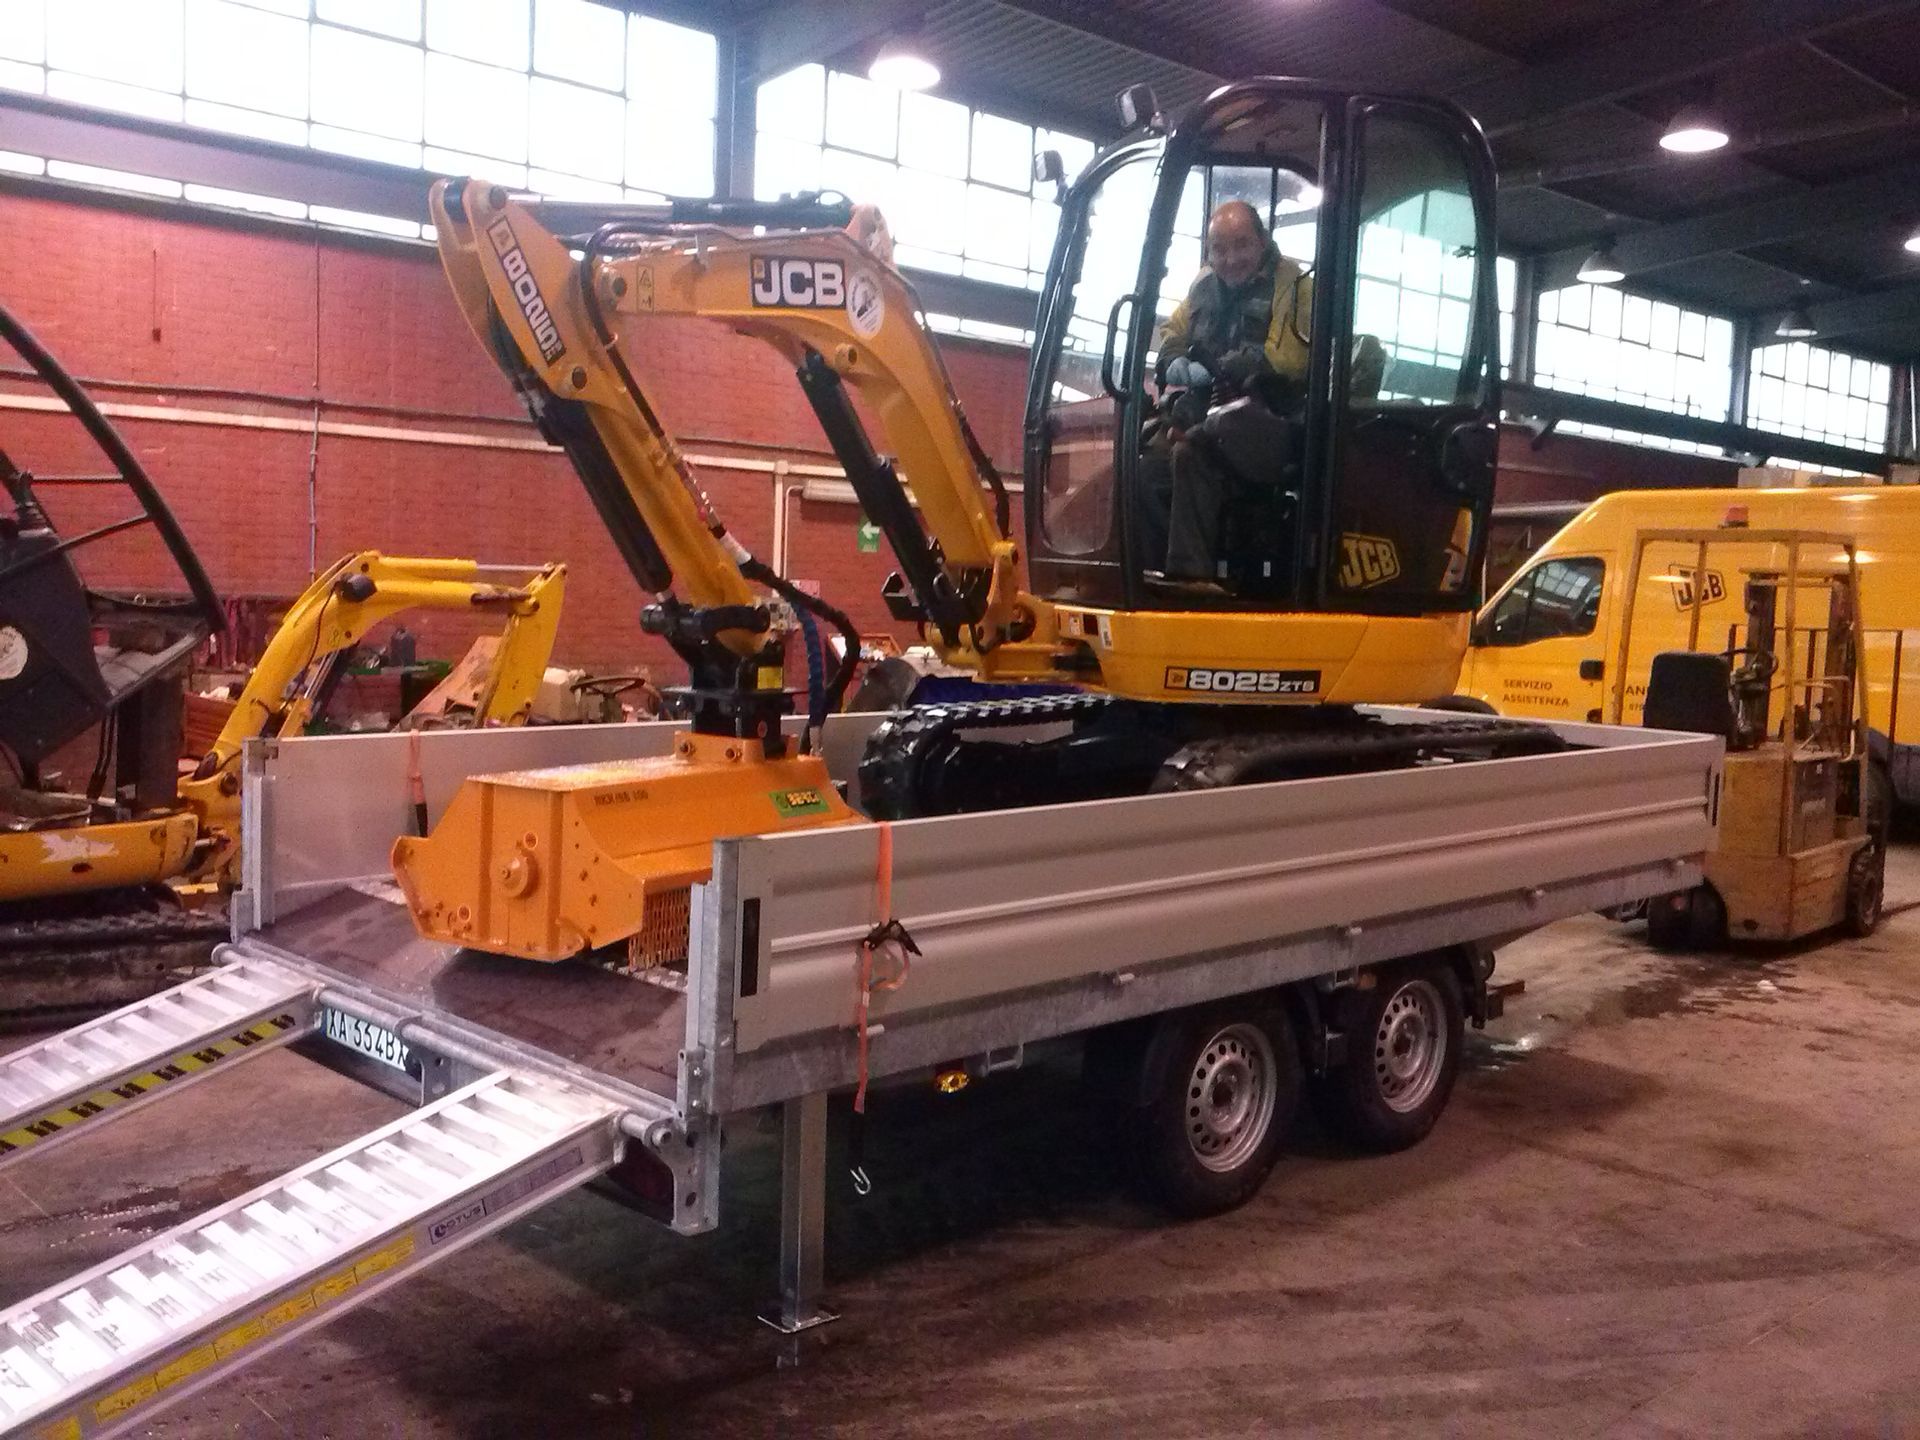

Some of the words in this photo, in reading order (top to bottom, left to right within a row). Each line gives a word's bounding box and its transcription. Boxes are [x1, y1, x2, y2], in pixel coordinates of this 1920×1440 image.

[754, 259, 844, 306] JCB
[1341, 538, 1396, 587] JCB
[1503, 679, 1553, 690] SERVIZIO
[1503, 693, 1570, 707] ASSISTENZA
